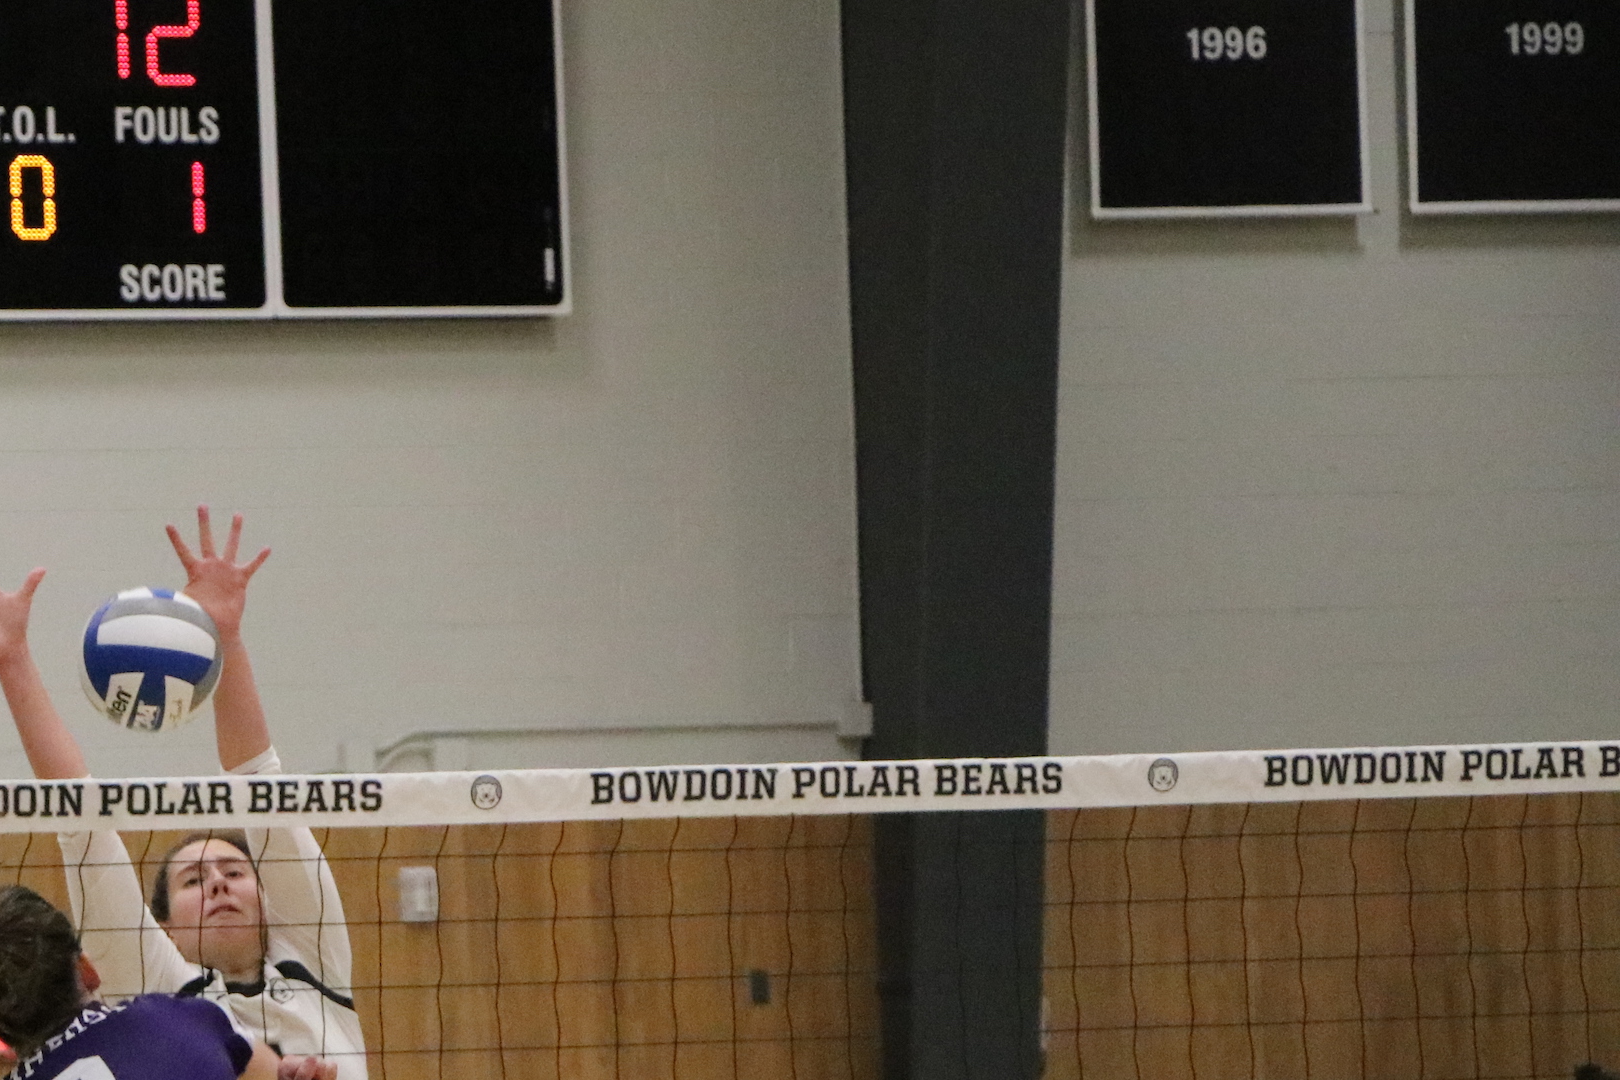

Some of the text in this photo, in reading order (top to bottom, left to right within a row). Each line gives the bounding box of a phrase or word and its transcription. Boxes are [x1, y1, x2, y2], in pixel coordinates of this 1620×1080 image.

[116, 0, 200, 86] 12
[1187, 26, 1266, 59] 1996
[1506, 22, 1583, 54] 1999
[115, 106, 219, 143] FOULS
[10, 155, 56, 240] 0
[192, 162, 205, 233] 1
[121, 264, 225, 301] SCORE
[591, 762, 1062, 805] BOWDOIN POLAR BEARS
[1264, 751, 1446, 787] BOWDOIN
[1460, 747, 1585, 781] POLAR
[99, 782, 233, 816] POLAR
[248, 780, 382, 813] BEARS
